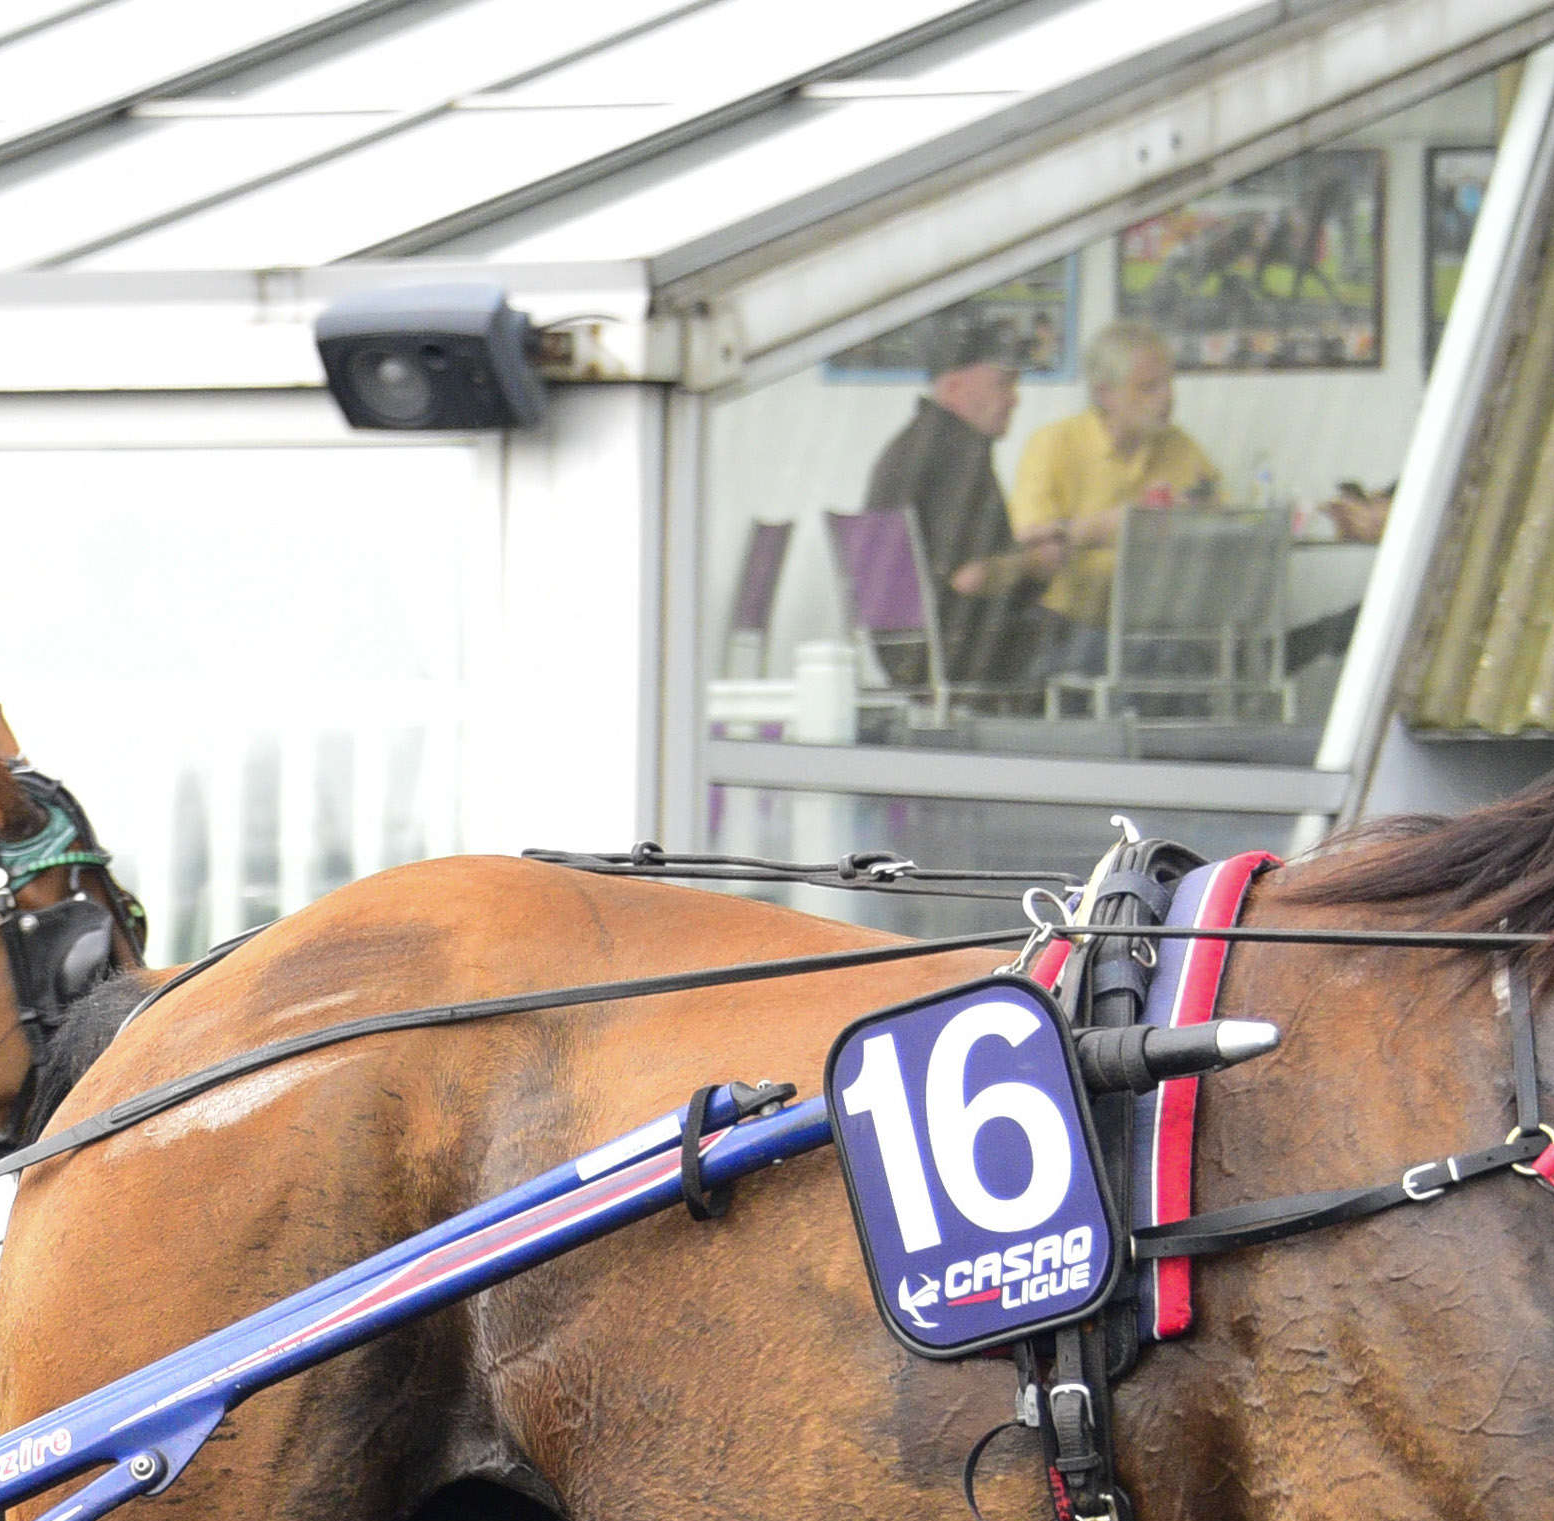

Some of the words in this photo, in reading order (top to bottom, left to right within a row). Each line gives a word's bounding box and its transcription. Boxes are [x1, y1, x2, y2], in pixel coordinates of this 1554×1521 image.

[842, 1002, 1072, 1254] 16
[945, 1226, 1093, 1294] CASAQ
[1001, 1262, 1091, 1311] LIGUE
